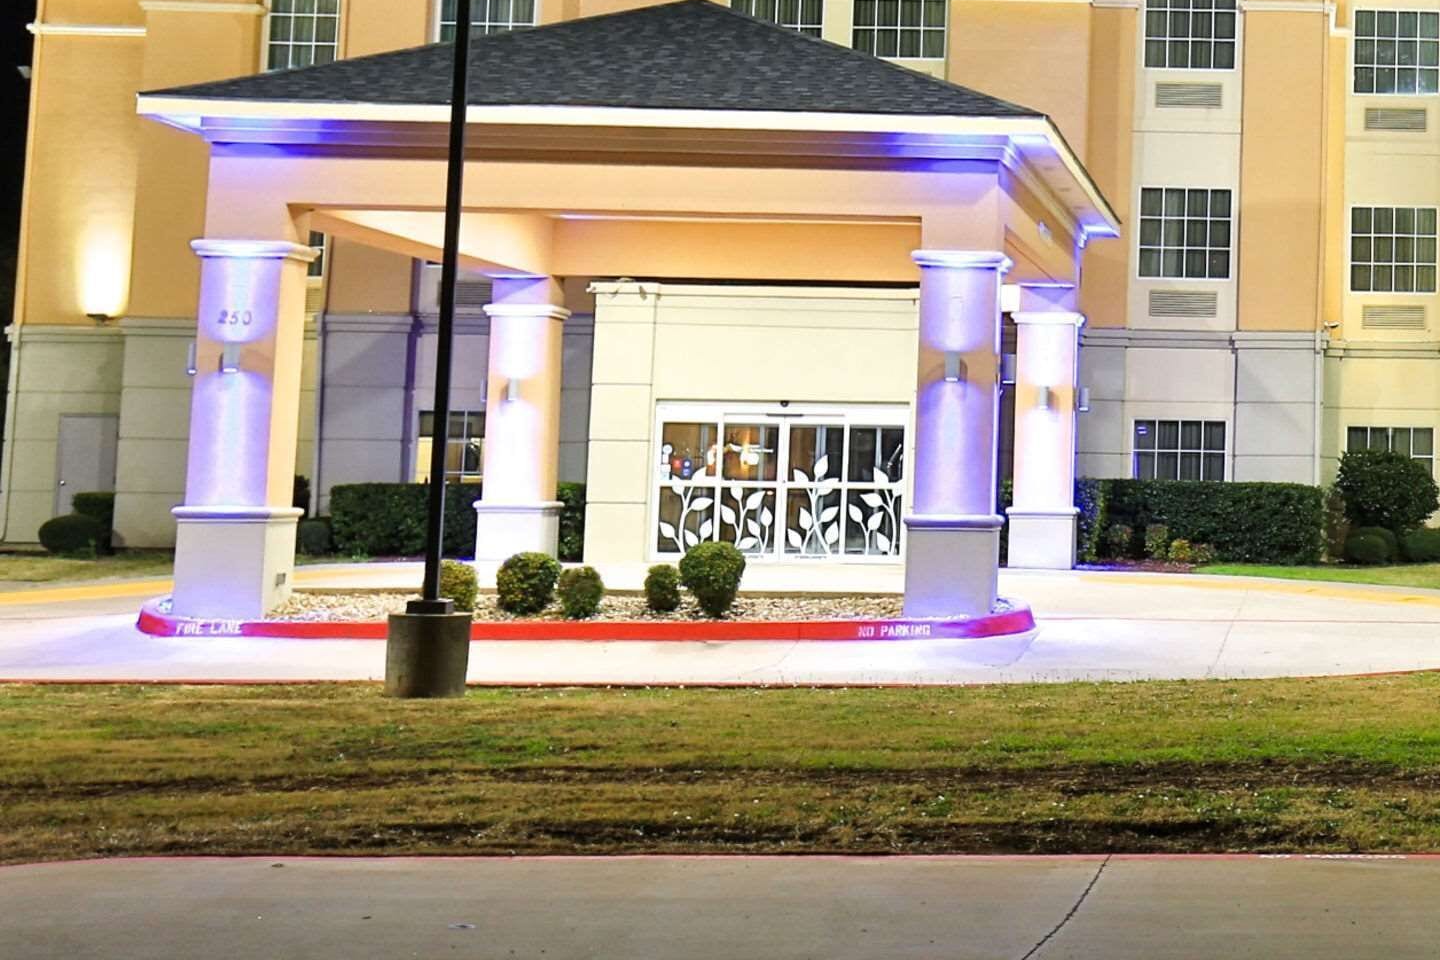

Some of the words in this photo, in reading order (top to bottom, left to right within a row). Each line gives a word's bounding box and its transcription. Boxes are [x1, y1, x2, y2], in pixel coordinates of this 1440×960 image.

[217, 309, 252, 325] 250
[176, 620, 203, 635] FIRE
[210, 620, 243, 634] LANE
[858, 625, 875, 637] NO
[880, 624, 931, 637] PARKING
